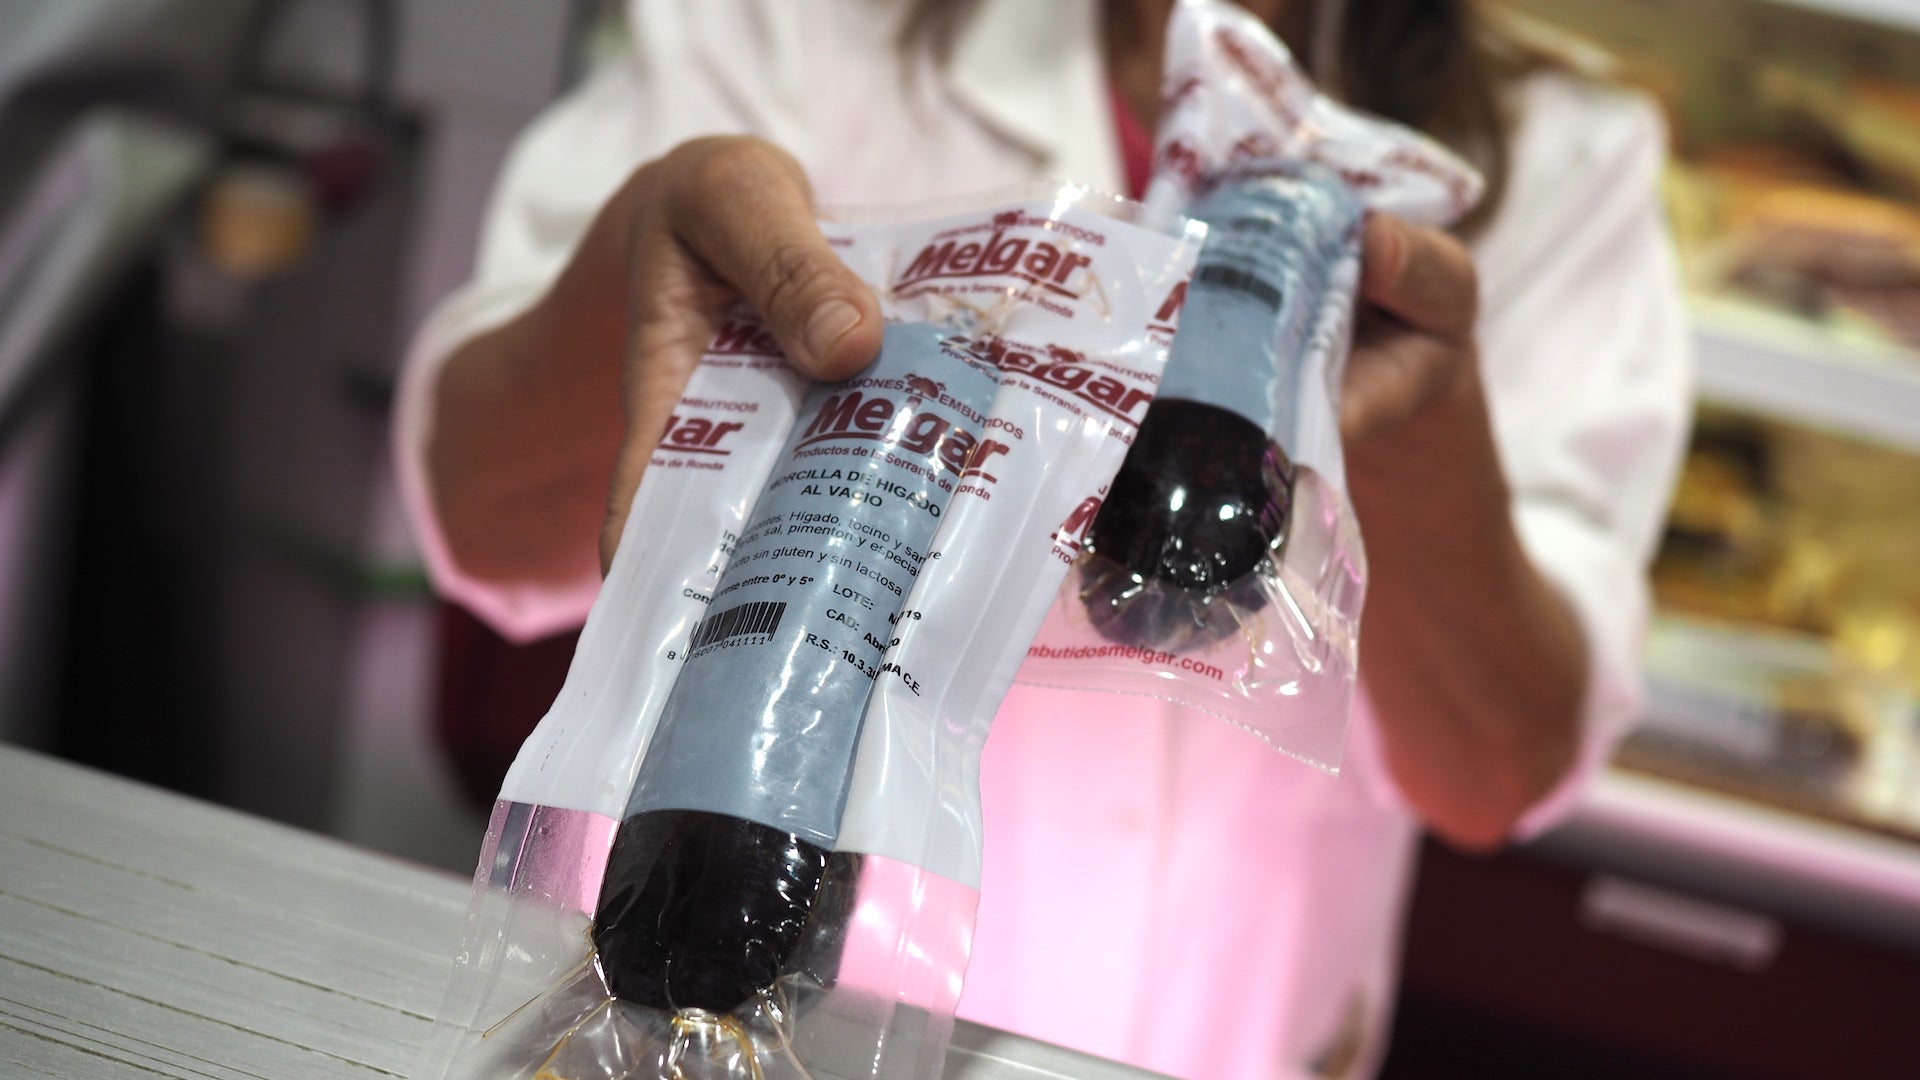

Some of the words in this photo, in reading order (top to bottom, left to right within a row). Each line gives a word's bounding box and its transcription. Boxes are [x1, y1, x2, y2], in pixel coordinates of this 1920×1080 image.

[902, 229, 1092, 285] Melgar
[1019, 379, 1031, 391] la
[680, 397, 760, 413] MBUTIDOS
[938, 393, 1024, 440] EMBUTIDOS
[802, 391, 1010, 469] Melgar
[793, 445, 849, 461] Productos
[852, 445, 869, 457] de
[937, 476, 953, 492] de
[800, 484, 822, 496] AL
[829, 485, 883, 507] VACIO
[846, 471, 873, 486] DE
[875, 478, 941, 518] HIGADO
[848, 517, 891, 543] tocino
[893, 540, 903, 551] y
[858, 536, 868, 548] y
[741, 575, 770, 589] entre
[787, 575, 798, 587] y
[752, 549, 769, 562] sin
[772, 545, 814, 559] gluten
[816, 551, 828, 563] y
[830, 553, 853, 569] sin
[855, 560, 903, 597] lactosa
[832, 583, 875, 611] LOTE:
[826, 608, 860, 632] CAD:
[667, 650, 677, 660] 8
[902, 672, 921, 697] C.E.
